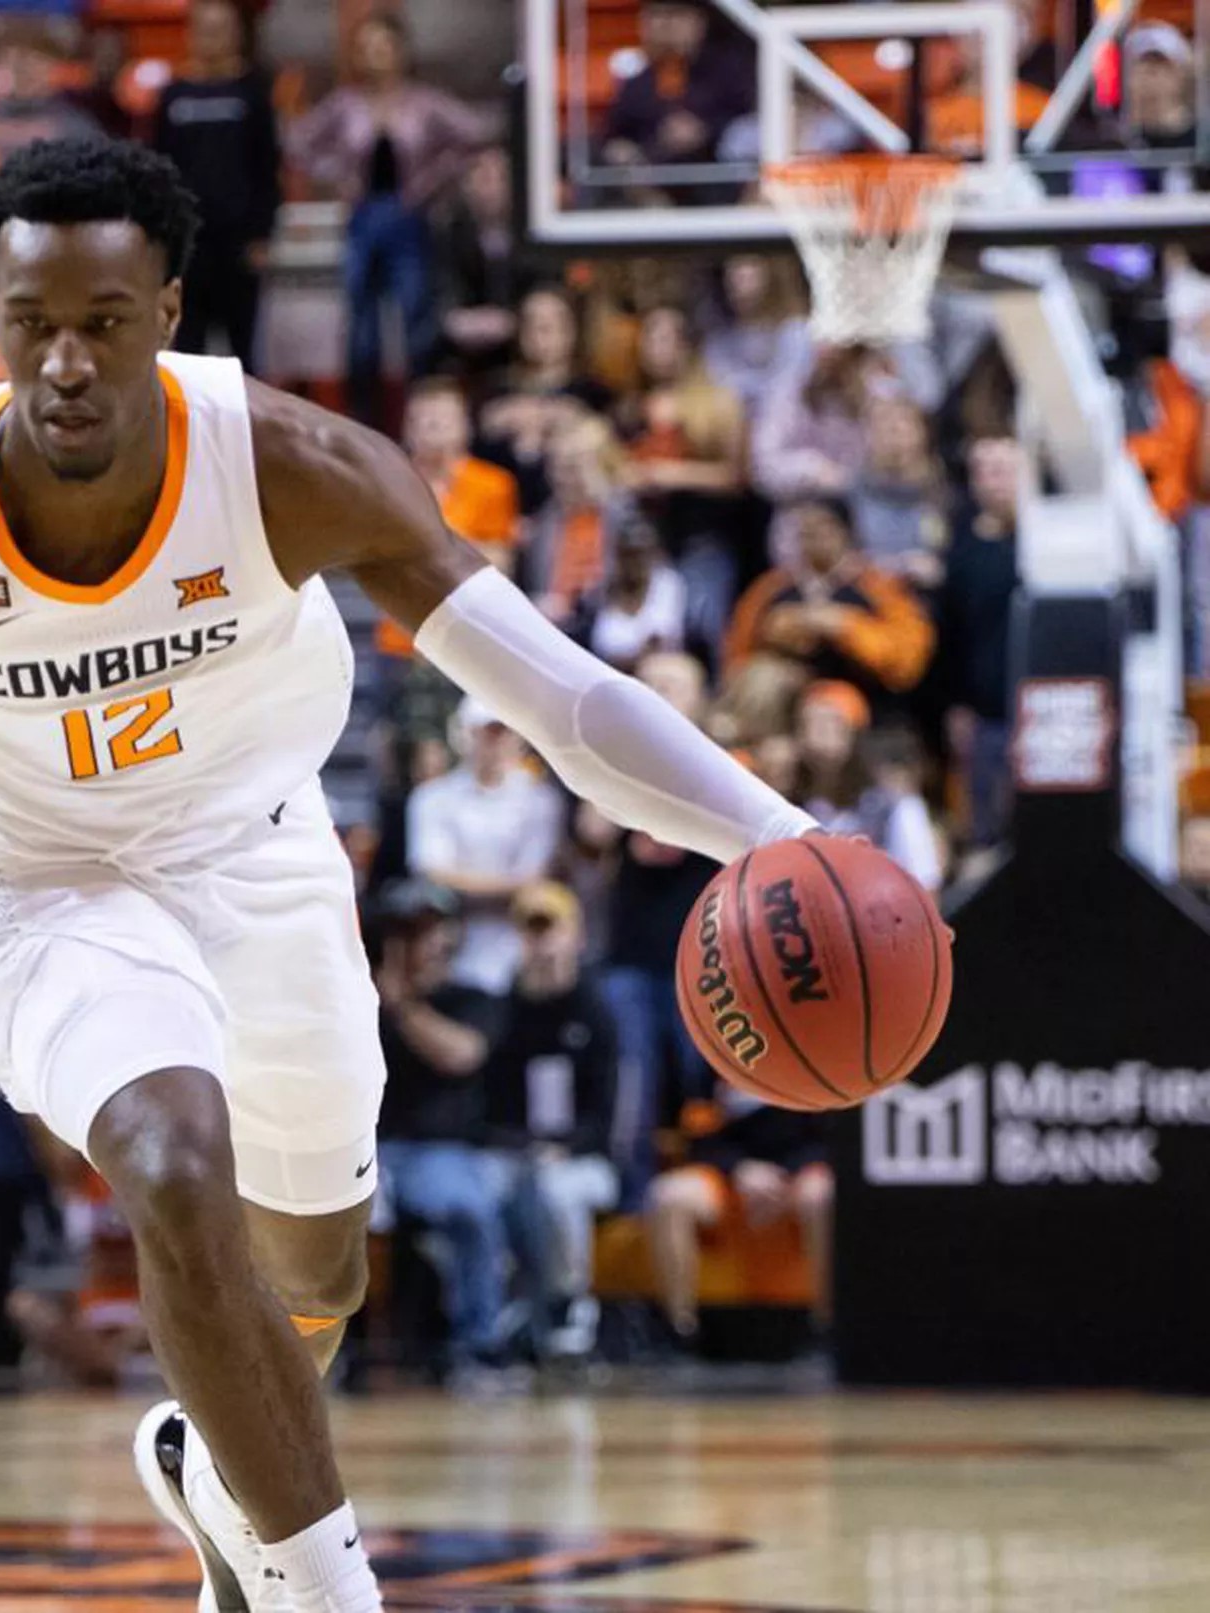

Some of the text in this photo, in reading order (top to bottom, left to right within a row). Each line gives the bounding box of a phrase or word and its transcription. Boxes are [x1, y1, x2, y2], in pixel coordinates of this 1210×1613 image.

[61, 687, 183, 781] 12
[696, 887, 768, 1069] Wilson
[763, 876, 829, 1003] NCAA
